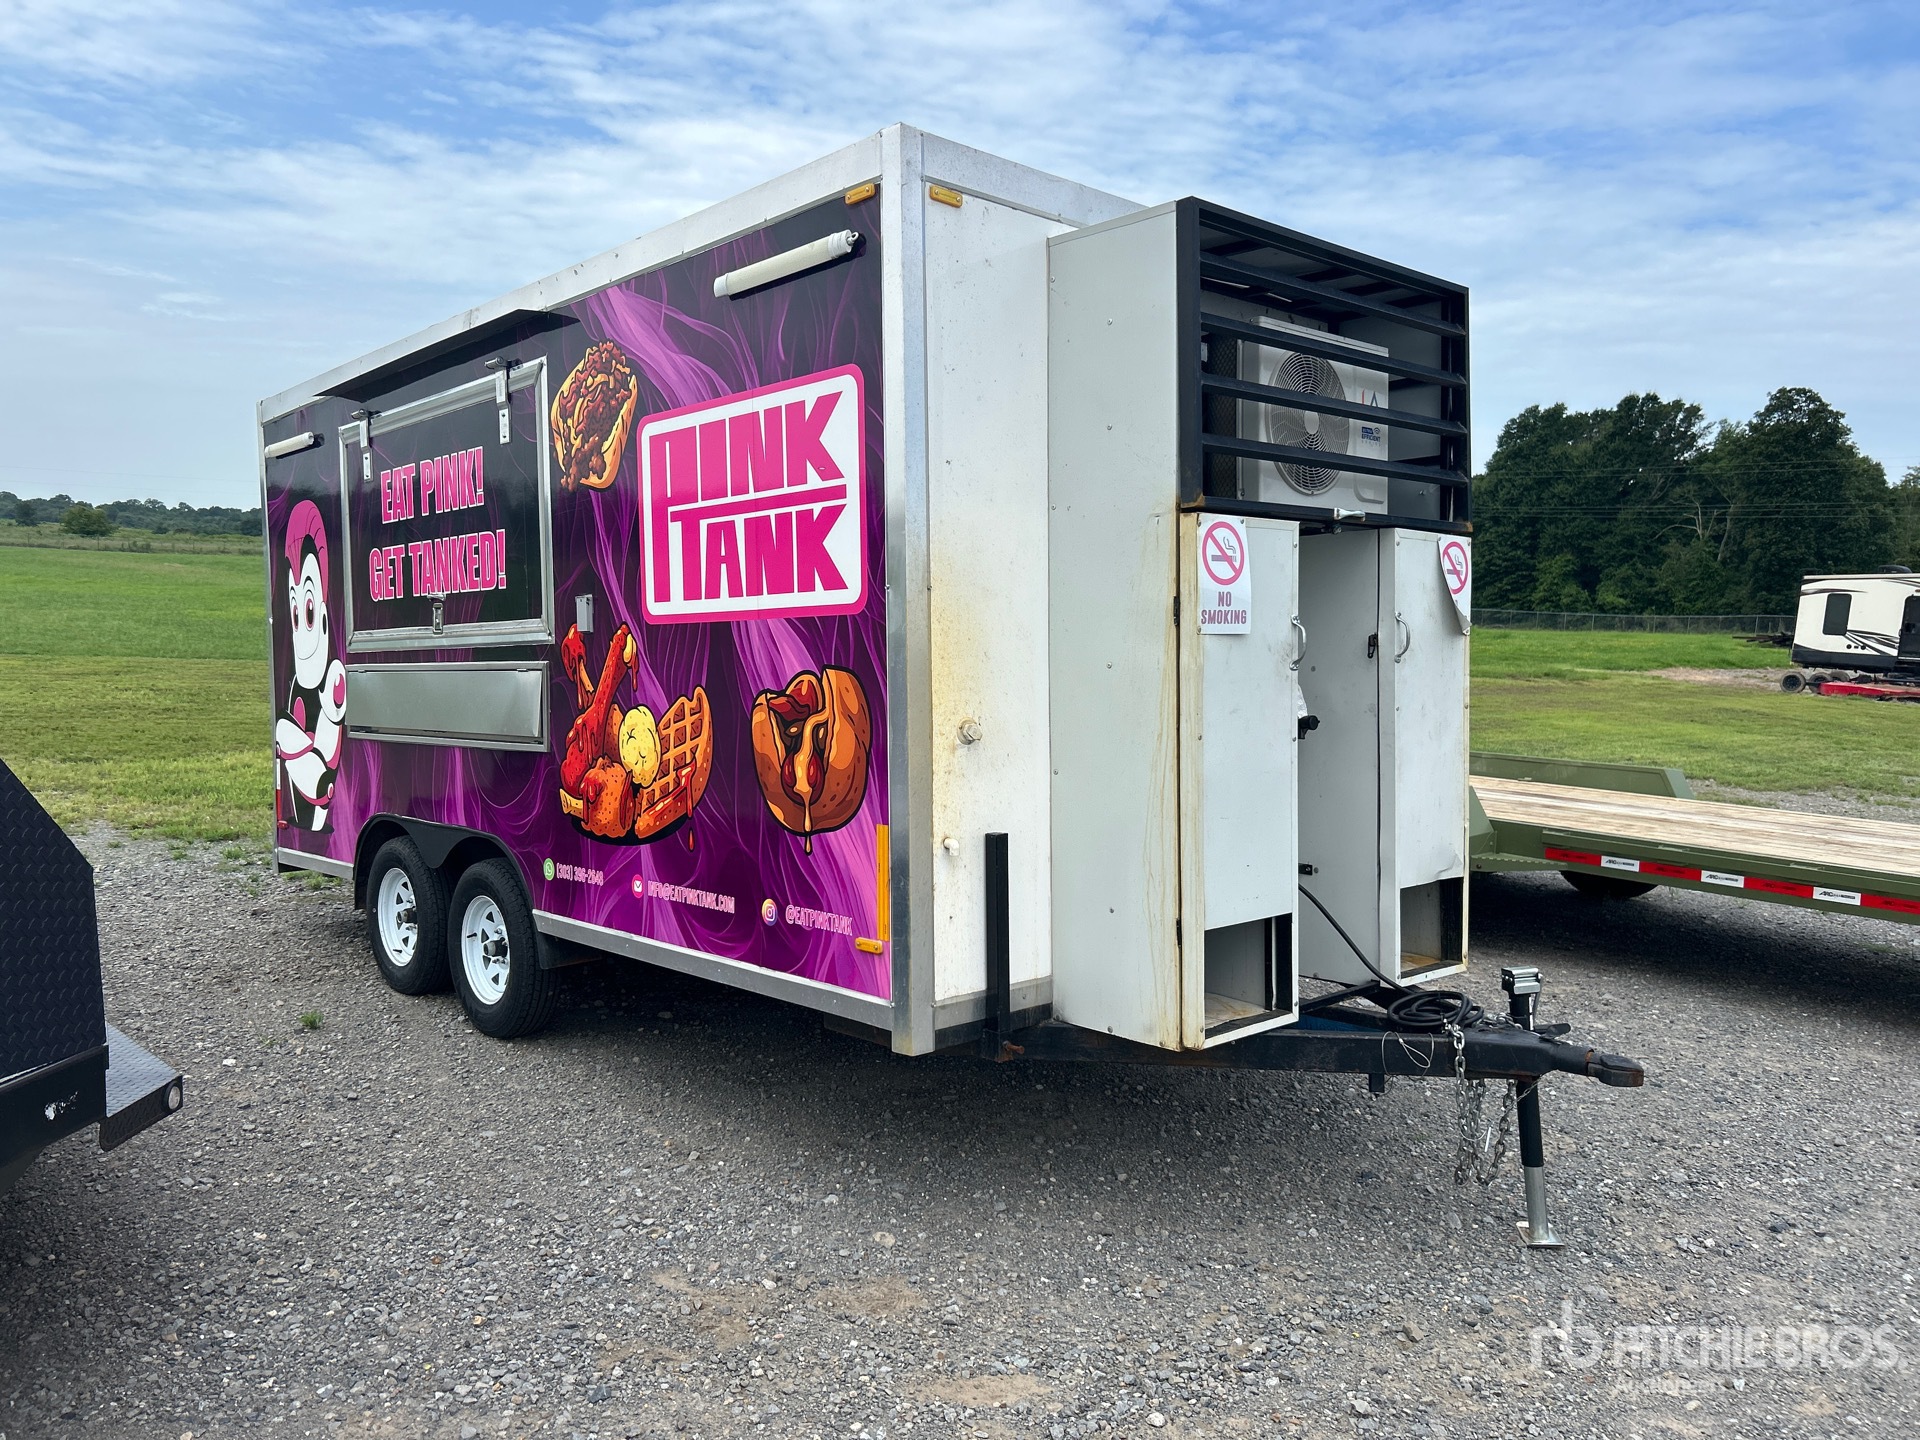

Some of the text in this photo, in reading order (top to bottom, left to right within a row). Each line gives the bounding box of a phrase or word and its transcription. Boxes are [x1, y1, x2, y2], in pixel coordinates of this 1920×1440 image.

[380, 446, 485, 524] EAT PINK!
[649, 391, 845, 603] PINK
[670, 484, 849, 601] TANK
[369, 529, 507, 602] GET TANKED!
[1217, 591, 1232, 607] NO
[1200, 609, 1247, 625] SMOKING
[556, 862, 573, 881] (303)
[647, 880, 735, 914] INFO@EATPINKTANK.COM
[785, 904, 853, 937] @EATPINKTANK
